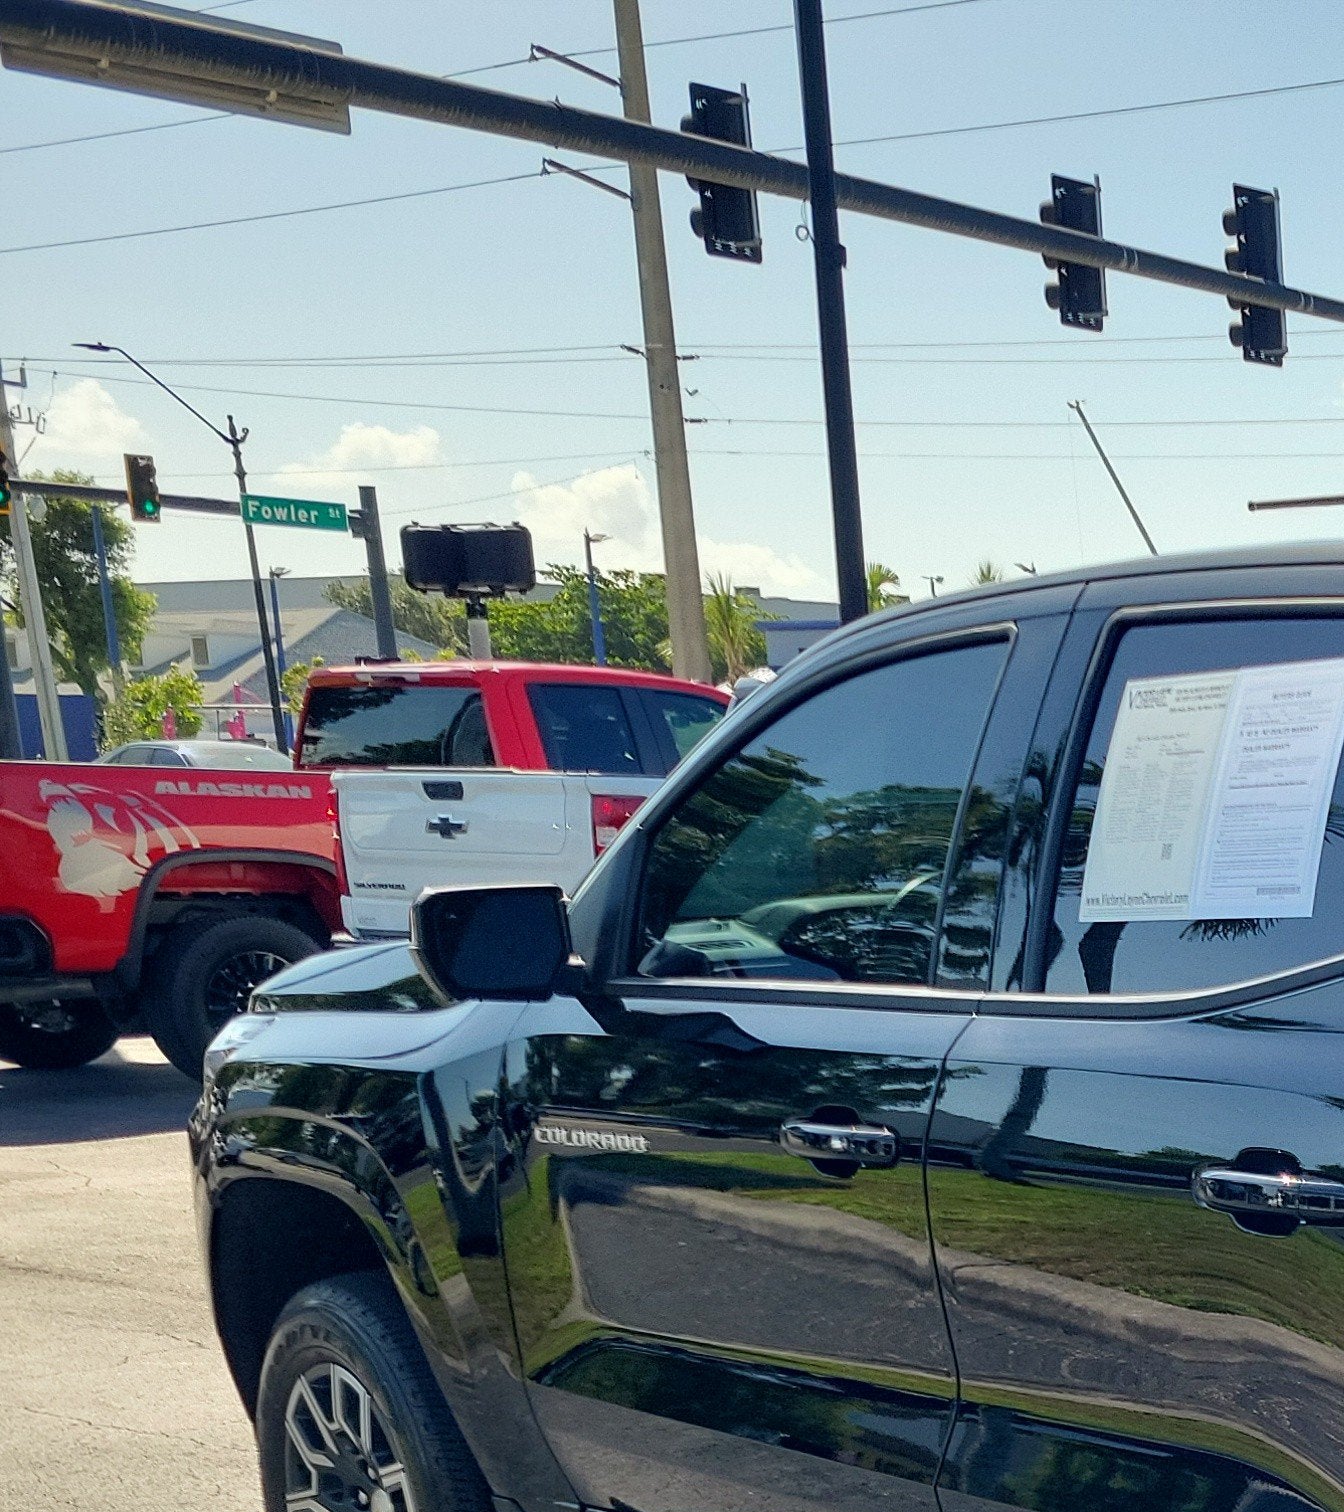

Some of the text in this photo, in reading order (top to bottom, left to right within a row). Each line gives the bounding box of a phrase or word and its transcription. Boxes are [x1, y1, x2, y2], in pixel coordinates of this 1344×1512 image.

[247, 499, 341, 524] Fowler St
[154, 781, 313, 799] ALASKAN
[534, 1126, 651, 1153] COLORADO
